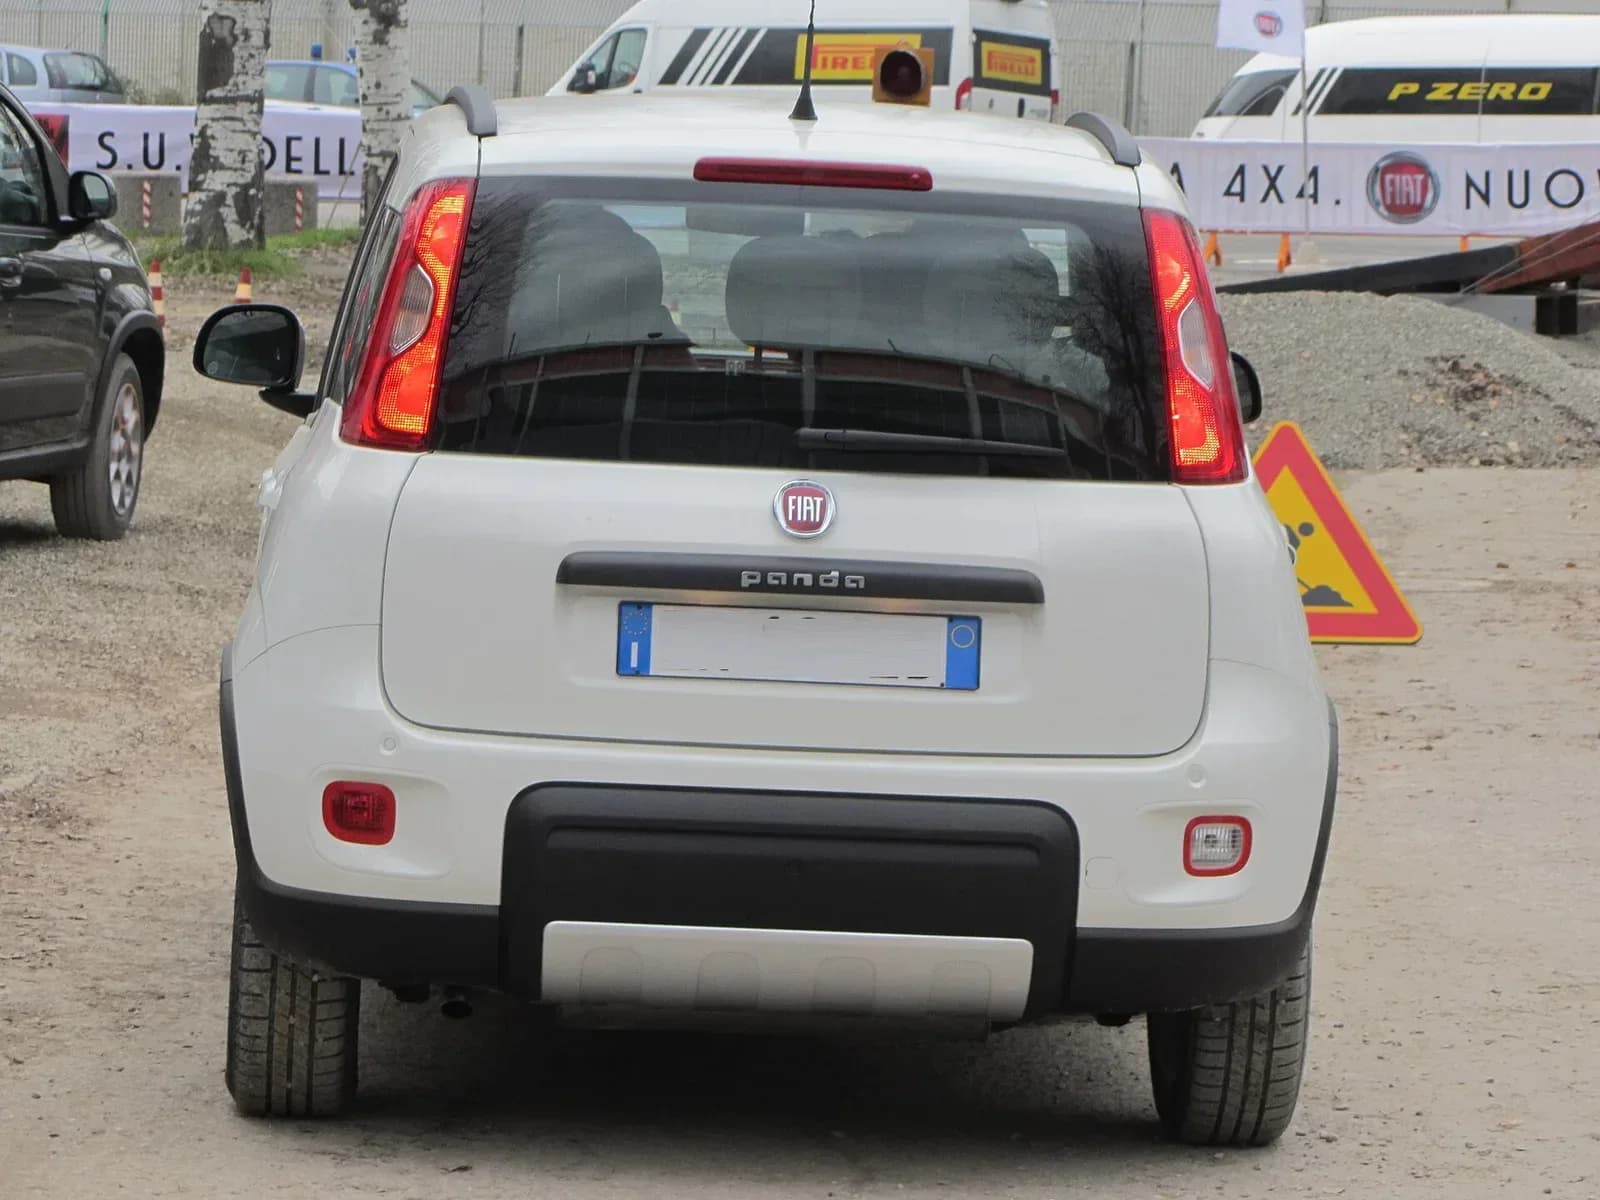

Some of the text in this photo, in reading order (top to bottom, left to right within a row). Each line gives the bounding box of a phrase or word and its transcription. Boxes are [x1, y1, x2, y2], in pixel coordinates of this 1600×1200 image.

[1387, 82, 1553, 101] P ZERO
[1222, 162, 1341, 206] 4X4.
[1383, 173, 1425, 206] FIAT
[1464, 168, 1600, 210] NUO
[788, 495, 824, 522] FIAT
[740, 570, 865, 589] panda
